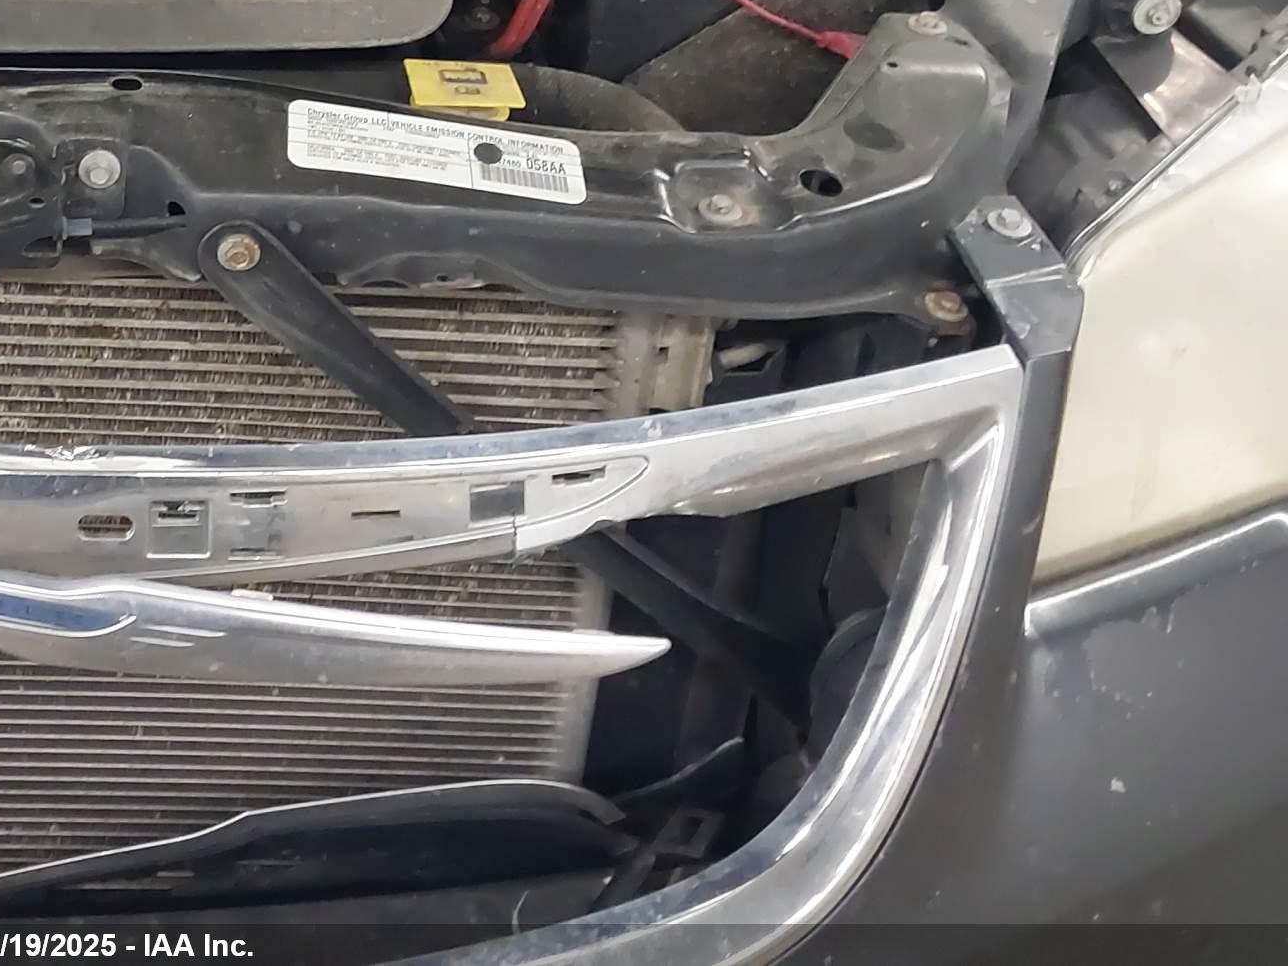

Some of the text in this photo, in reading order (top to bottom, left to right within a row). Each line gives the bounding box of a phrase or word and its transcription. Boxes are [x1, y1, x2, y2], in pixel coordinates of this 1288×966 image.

[391, 121, 423, 132] VEHICLE
[426, 126, 465, 139] EMISSION
[467, 132, 504, 145] CONTROL
[507, 139, 564, 155] INFORMATION
